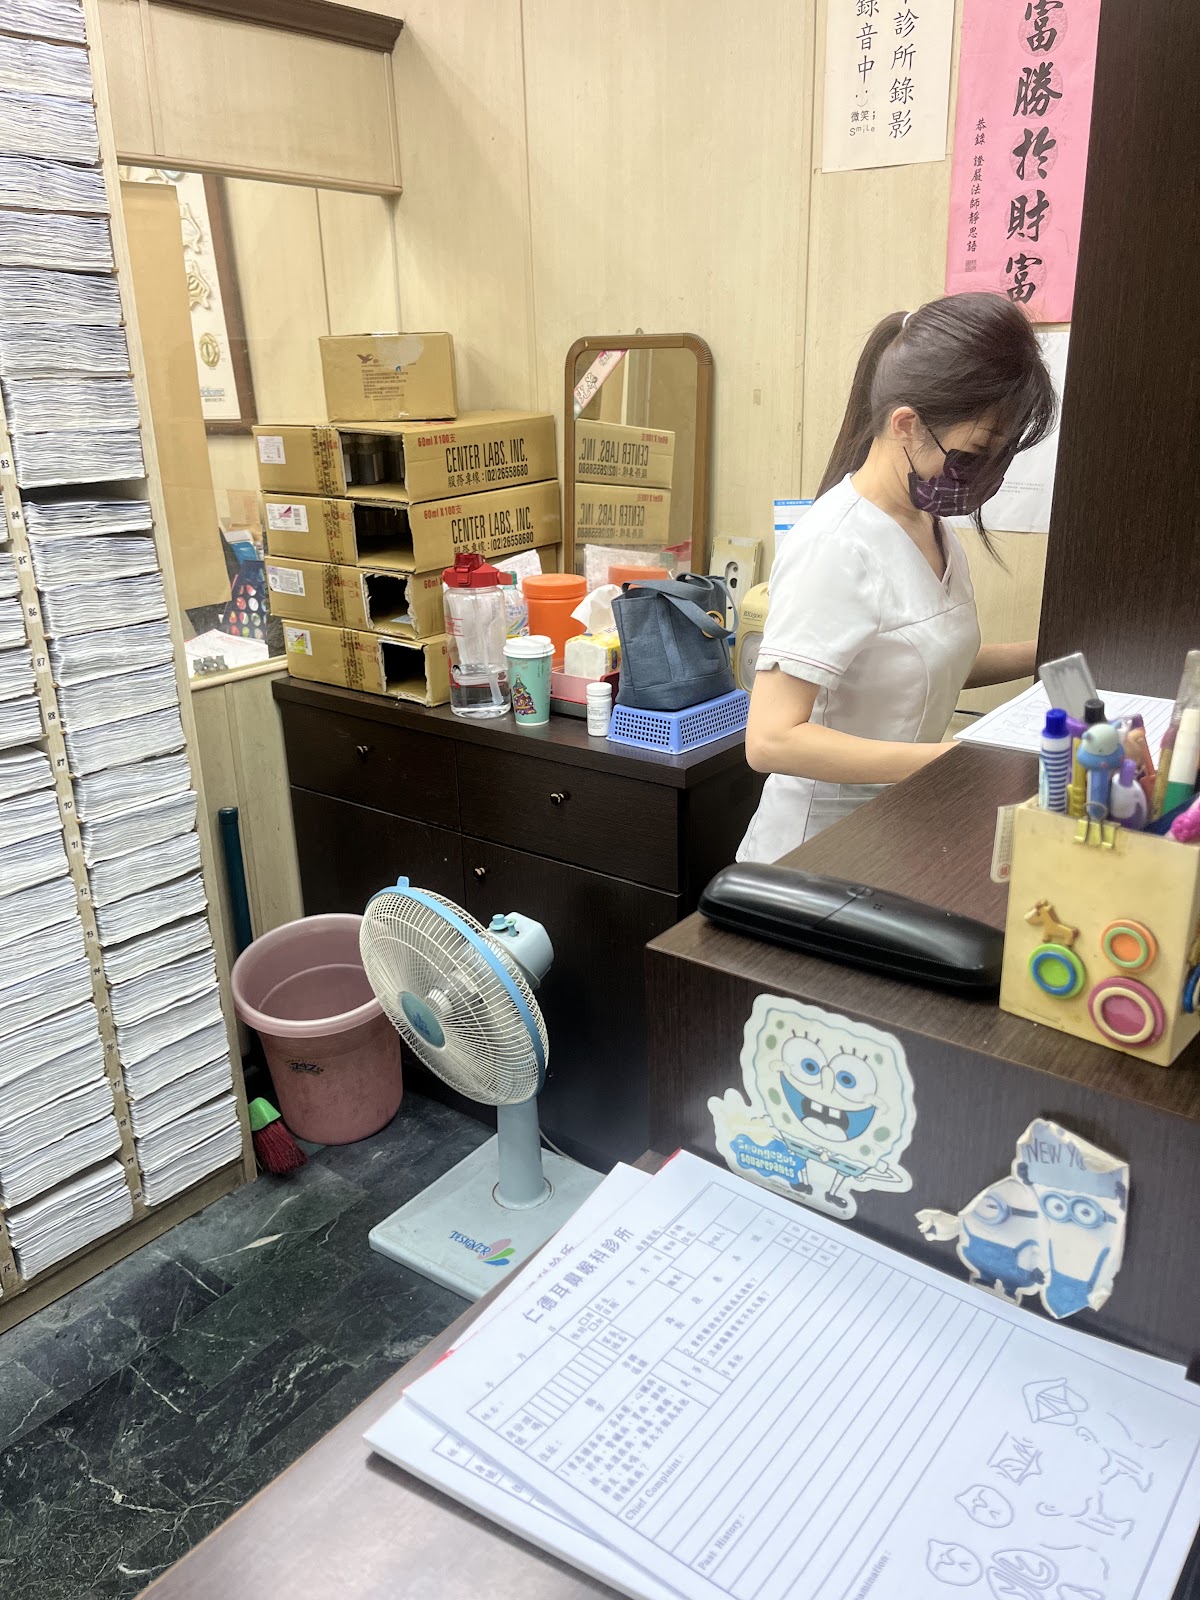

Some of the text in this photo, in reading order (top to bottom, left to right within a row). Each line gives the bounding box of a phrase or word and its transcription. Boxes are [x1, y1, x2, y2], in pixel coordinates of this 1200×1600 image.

[888, 0, 919, 139] 診所錄影
[445, 438, 528, 473] CENTER LABS. INC.
[451, 506, 534, 544] CENTER LABS. INC.
[1026, 1138, 1061, 1164] NEW
[449, 1230, 491, 1256] DESIGNER
[625, 1498, 646, 1520] Chief
[698, 1551, 717, 1570] Past
